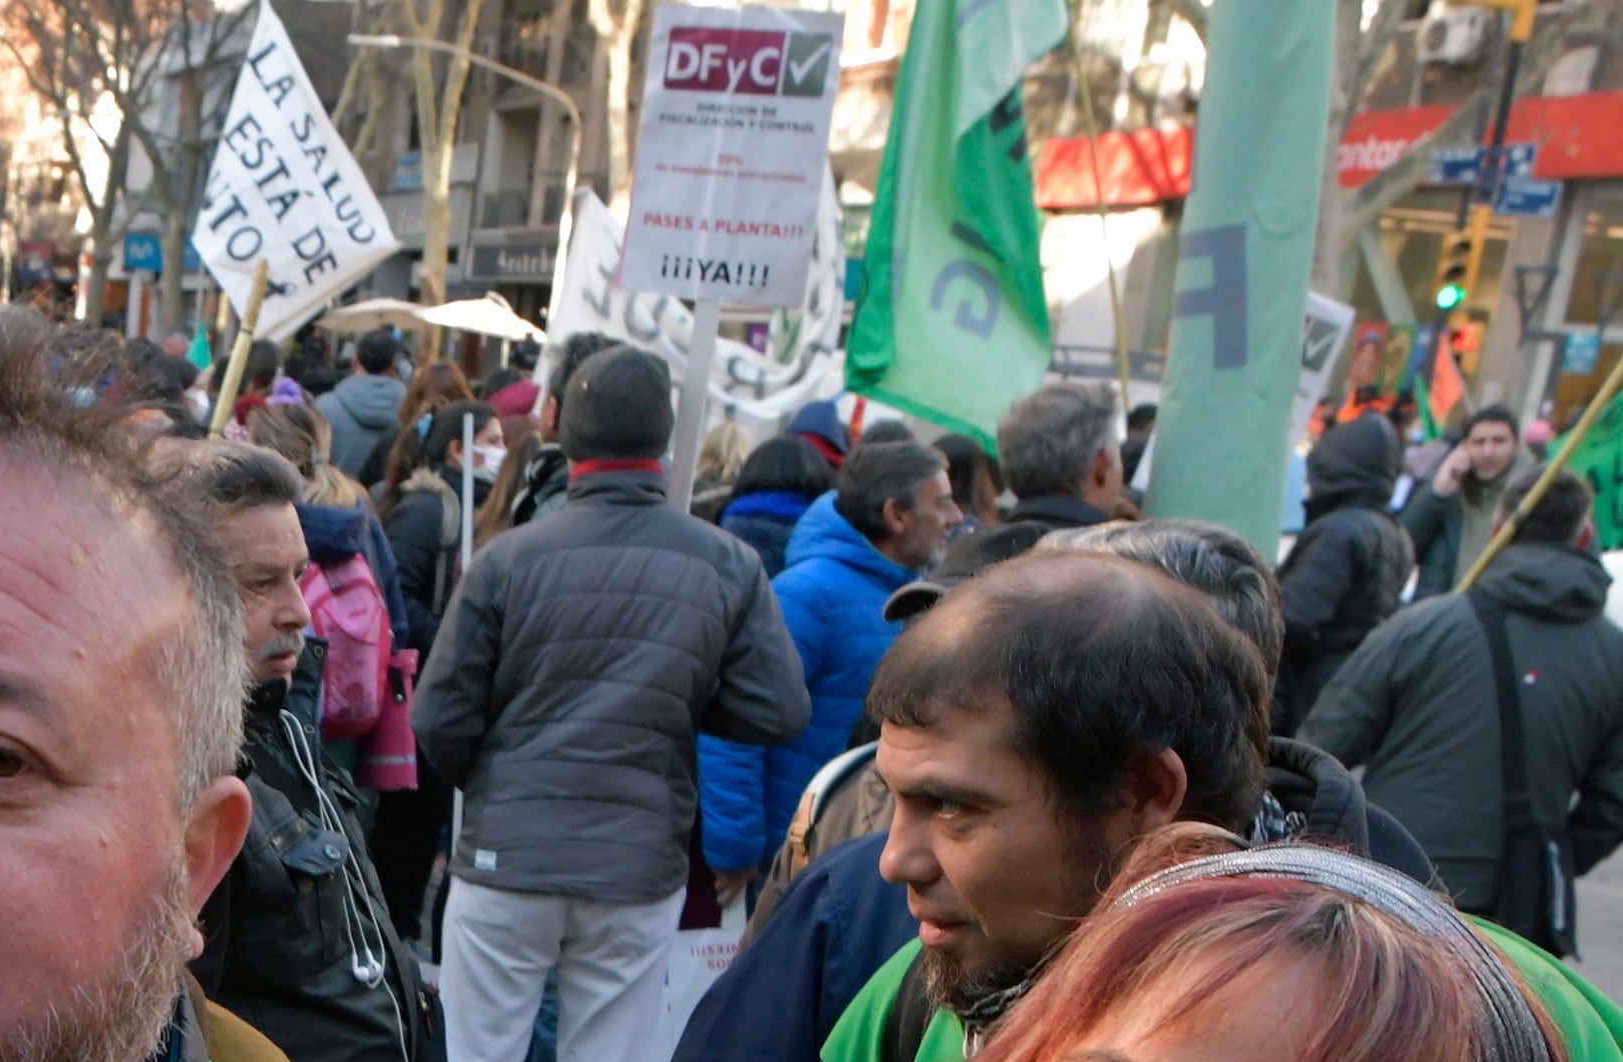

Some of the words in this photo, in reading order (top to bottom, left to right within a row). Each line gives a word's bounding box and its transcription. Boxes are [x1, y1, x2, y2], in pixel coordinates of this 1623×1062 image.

[666, 42, 780, 94] DFyC
[249, 40, 295, 109] LA
[290, 112, 376, 245] SALUD
[225, 112, 315, 228] ESTÁ
[292, 226, 338, 285] DE
[643, 211, 695, 230] PASES
[700, 218, 709, 231] A
[715, 219, 804, 239] PLANTA!!!
[661, 254, 770, 287] ¡¡¡YA!!!
